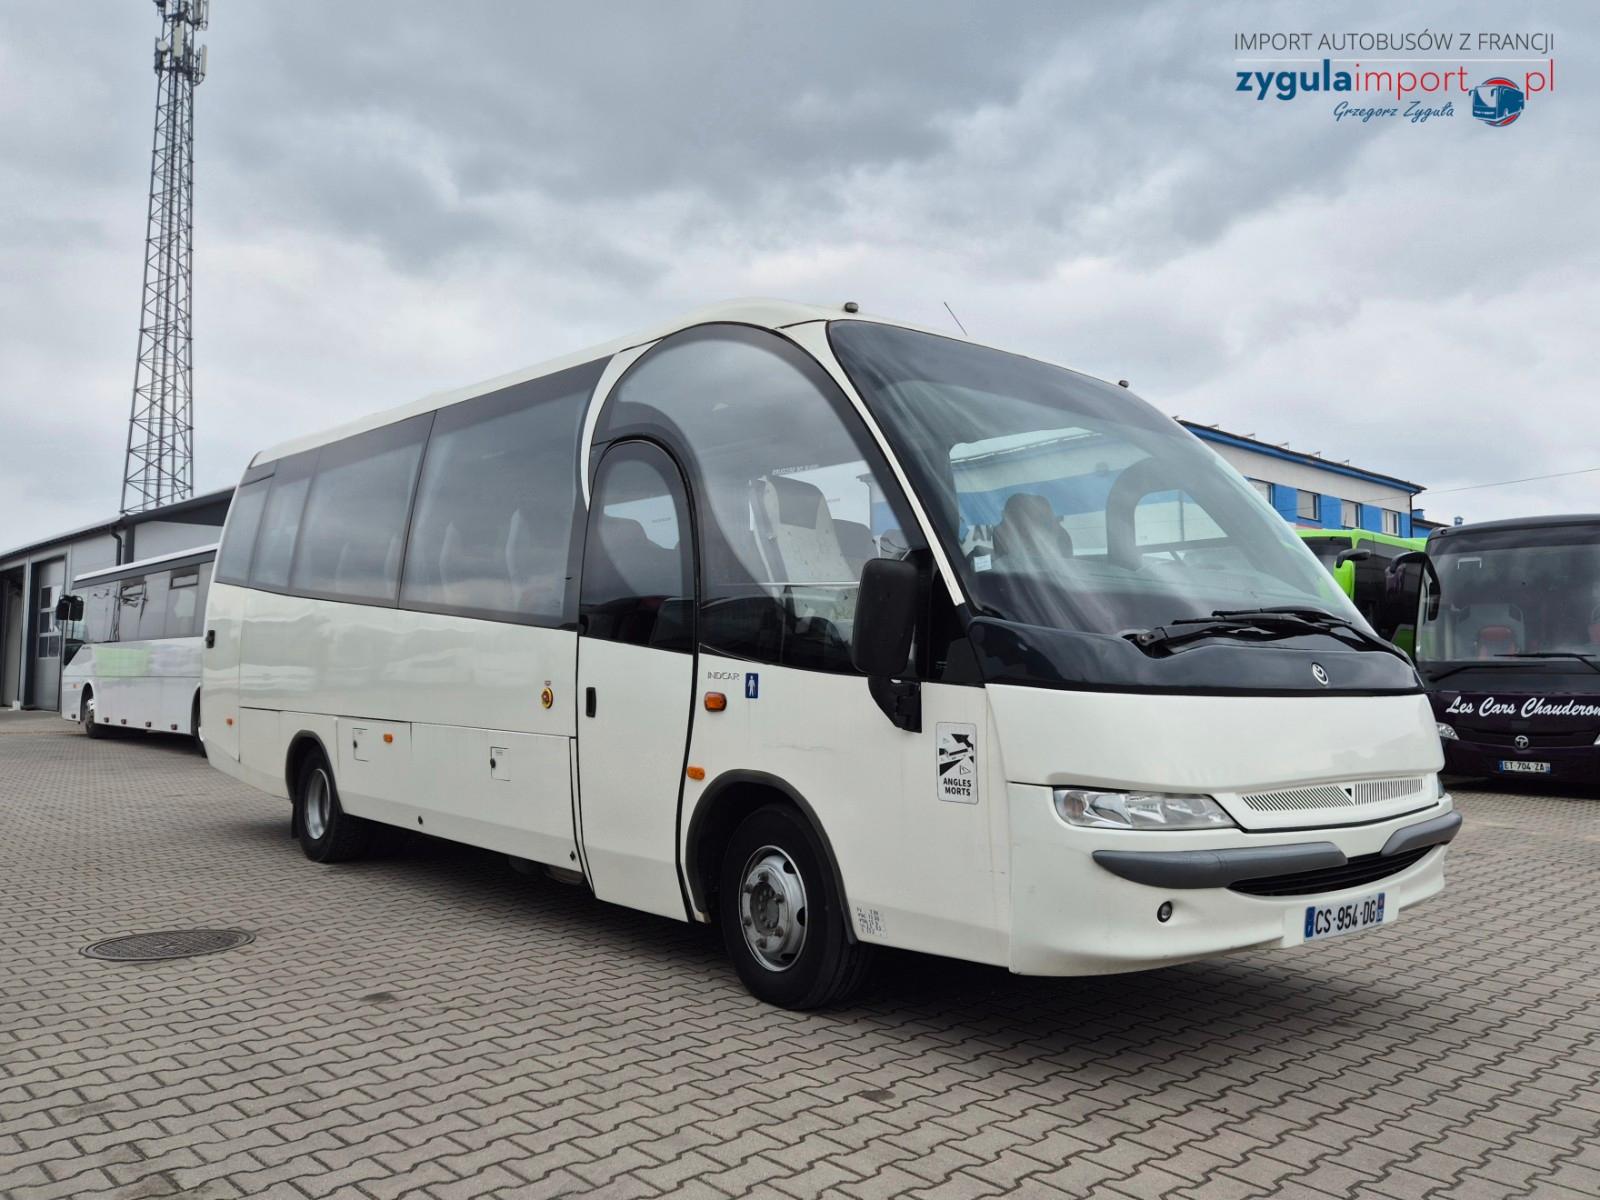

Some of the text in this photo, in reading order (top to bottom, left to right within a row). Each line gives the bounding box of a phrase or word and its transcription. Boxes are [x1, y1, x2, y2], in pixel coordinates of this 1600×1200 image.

[1445, 695, 1474, 714] Les
[1478, 696, 1517, 717] Cars
[943, 777, 972, 788] ANGLES
[944, 786, 971, 797] MORTS
